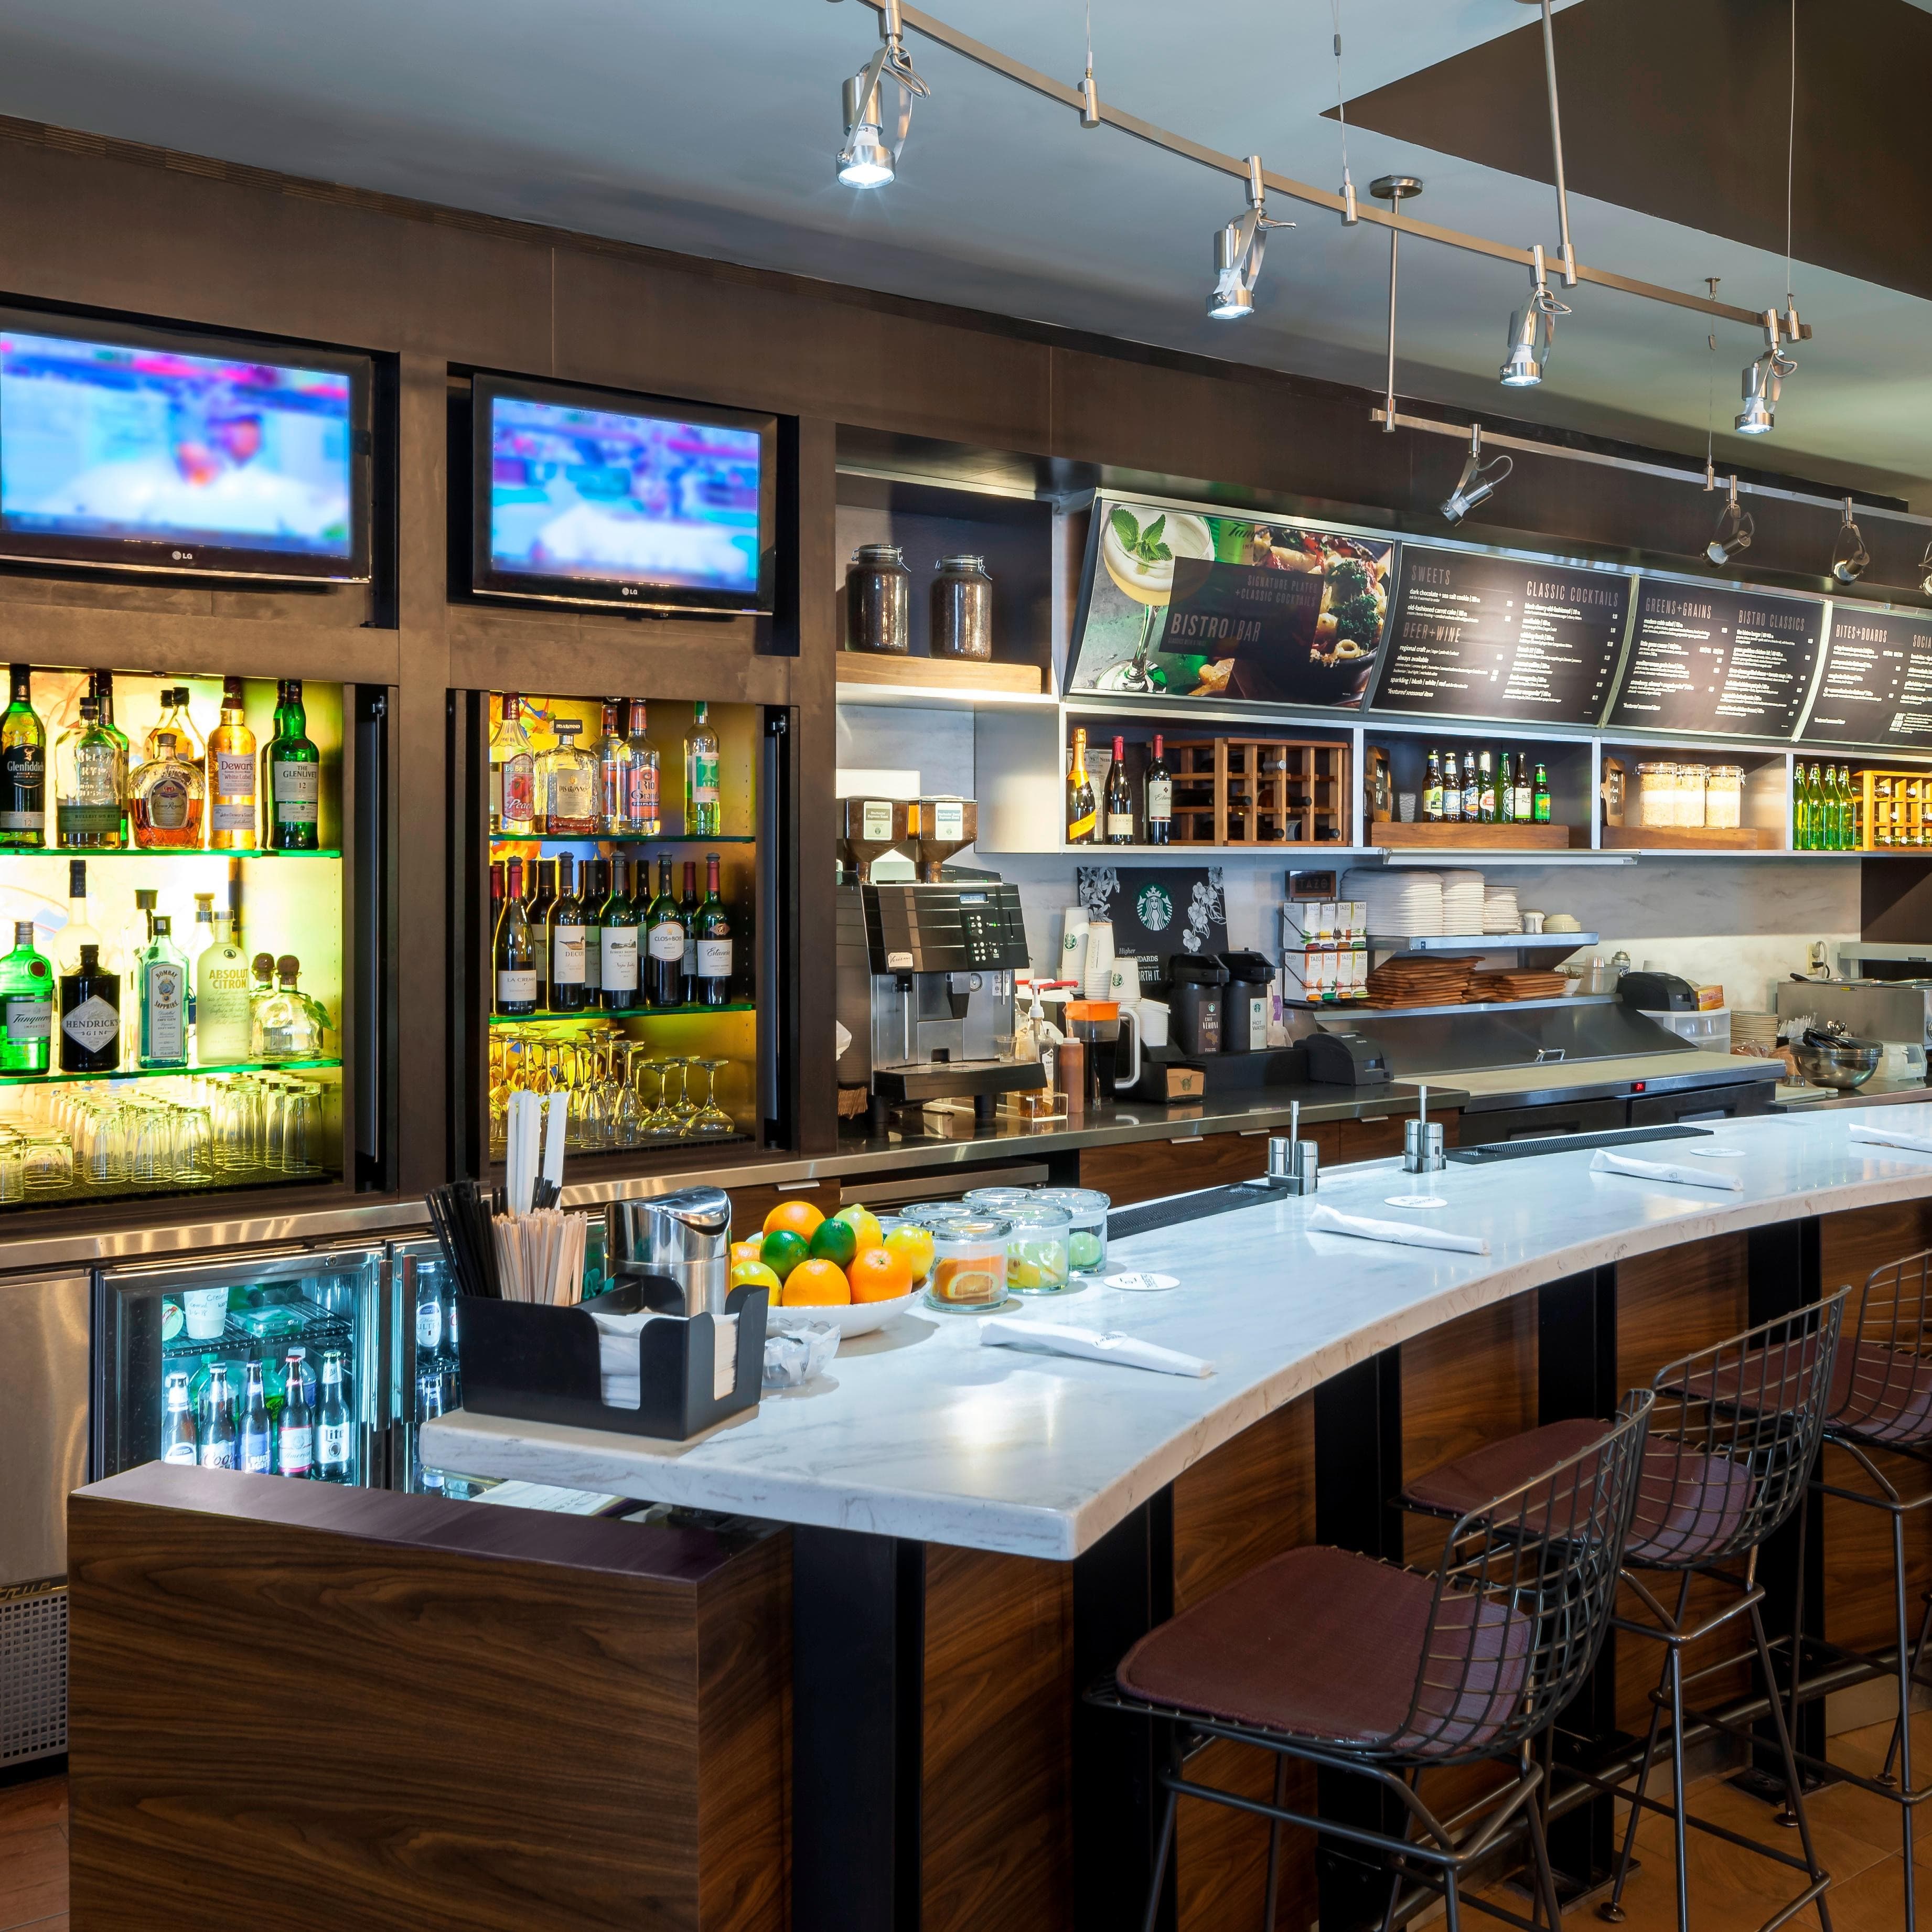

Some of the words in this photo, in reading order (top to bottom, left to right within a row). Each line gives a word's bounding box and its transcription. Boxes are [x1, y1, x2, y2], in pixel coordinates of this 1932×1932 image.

[1411, 565, 1450, 585] SWEETS
[1248, 575, 1287, 591] SIGNATURE
[1292, 581, 1318, 594] PLATES
[1276, 592, 1316, 607] COCKTAILS
[1420, 589, 1438, 598] chocolate
[1527, 581, 1565, 600] CLASSIC
[1570, 587, 1619, 607] COCKTAILS
[1408, 604, 1434, 614] old-fashioned
[1646, 597, 1712, 619] GREENS+GRAINS
[1738, 609, 1766, 627] BISTRO
[1770, 614, 1805, 631] CLASSICS
[1171, 613, 1229, 639] BISTRO
[1237, 620, 1261, 643] BAR
[1836, 624, 1887, 643] BITES+BOARDS
[508, 799, 534, 809] Peach
[1300, 878, 1327, 889] TAZO
[155, 970, 178, 980] BOMBAY
[209, 969, 249, 979] ABSOLUT
[212, 979, 246, 989] CITRON
[154, 1000, 179, 1010] SAPPHIRE
[66, 1019, 118, 1028] HENDRICK'S
[326, 1429, 344, 1442] Lite
